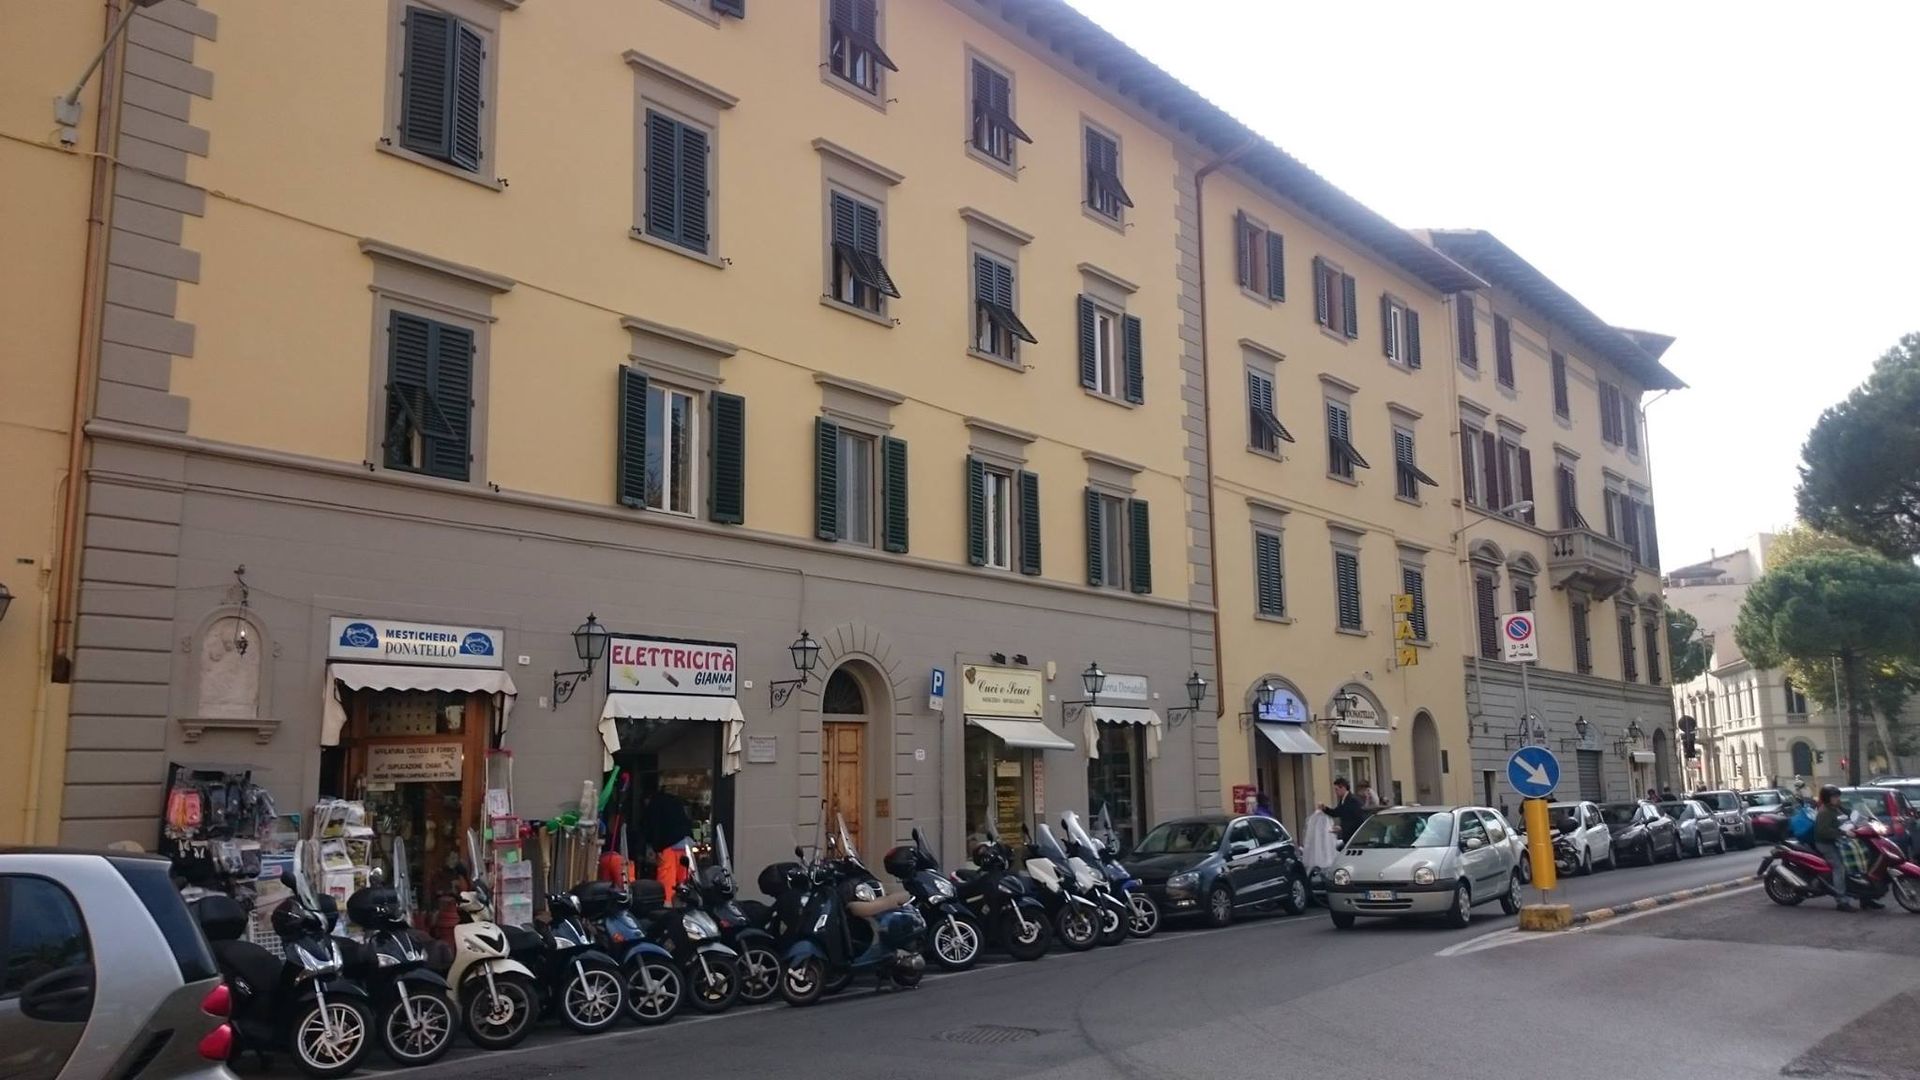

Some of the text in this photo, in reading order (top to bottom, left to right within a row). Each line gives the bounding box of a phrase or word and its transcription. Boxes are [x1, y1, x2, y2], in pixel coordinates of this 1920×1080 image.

[385, 629, 458, 643] MESTICHERIA
[385, 641, 457, 658] DONATELLO
[612, 645, 734, 672] ELETTRICITÀ
[694, 671, 733, 686] GIANNA
[933, 670, 943, 694] P
